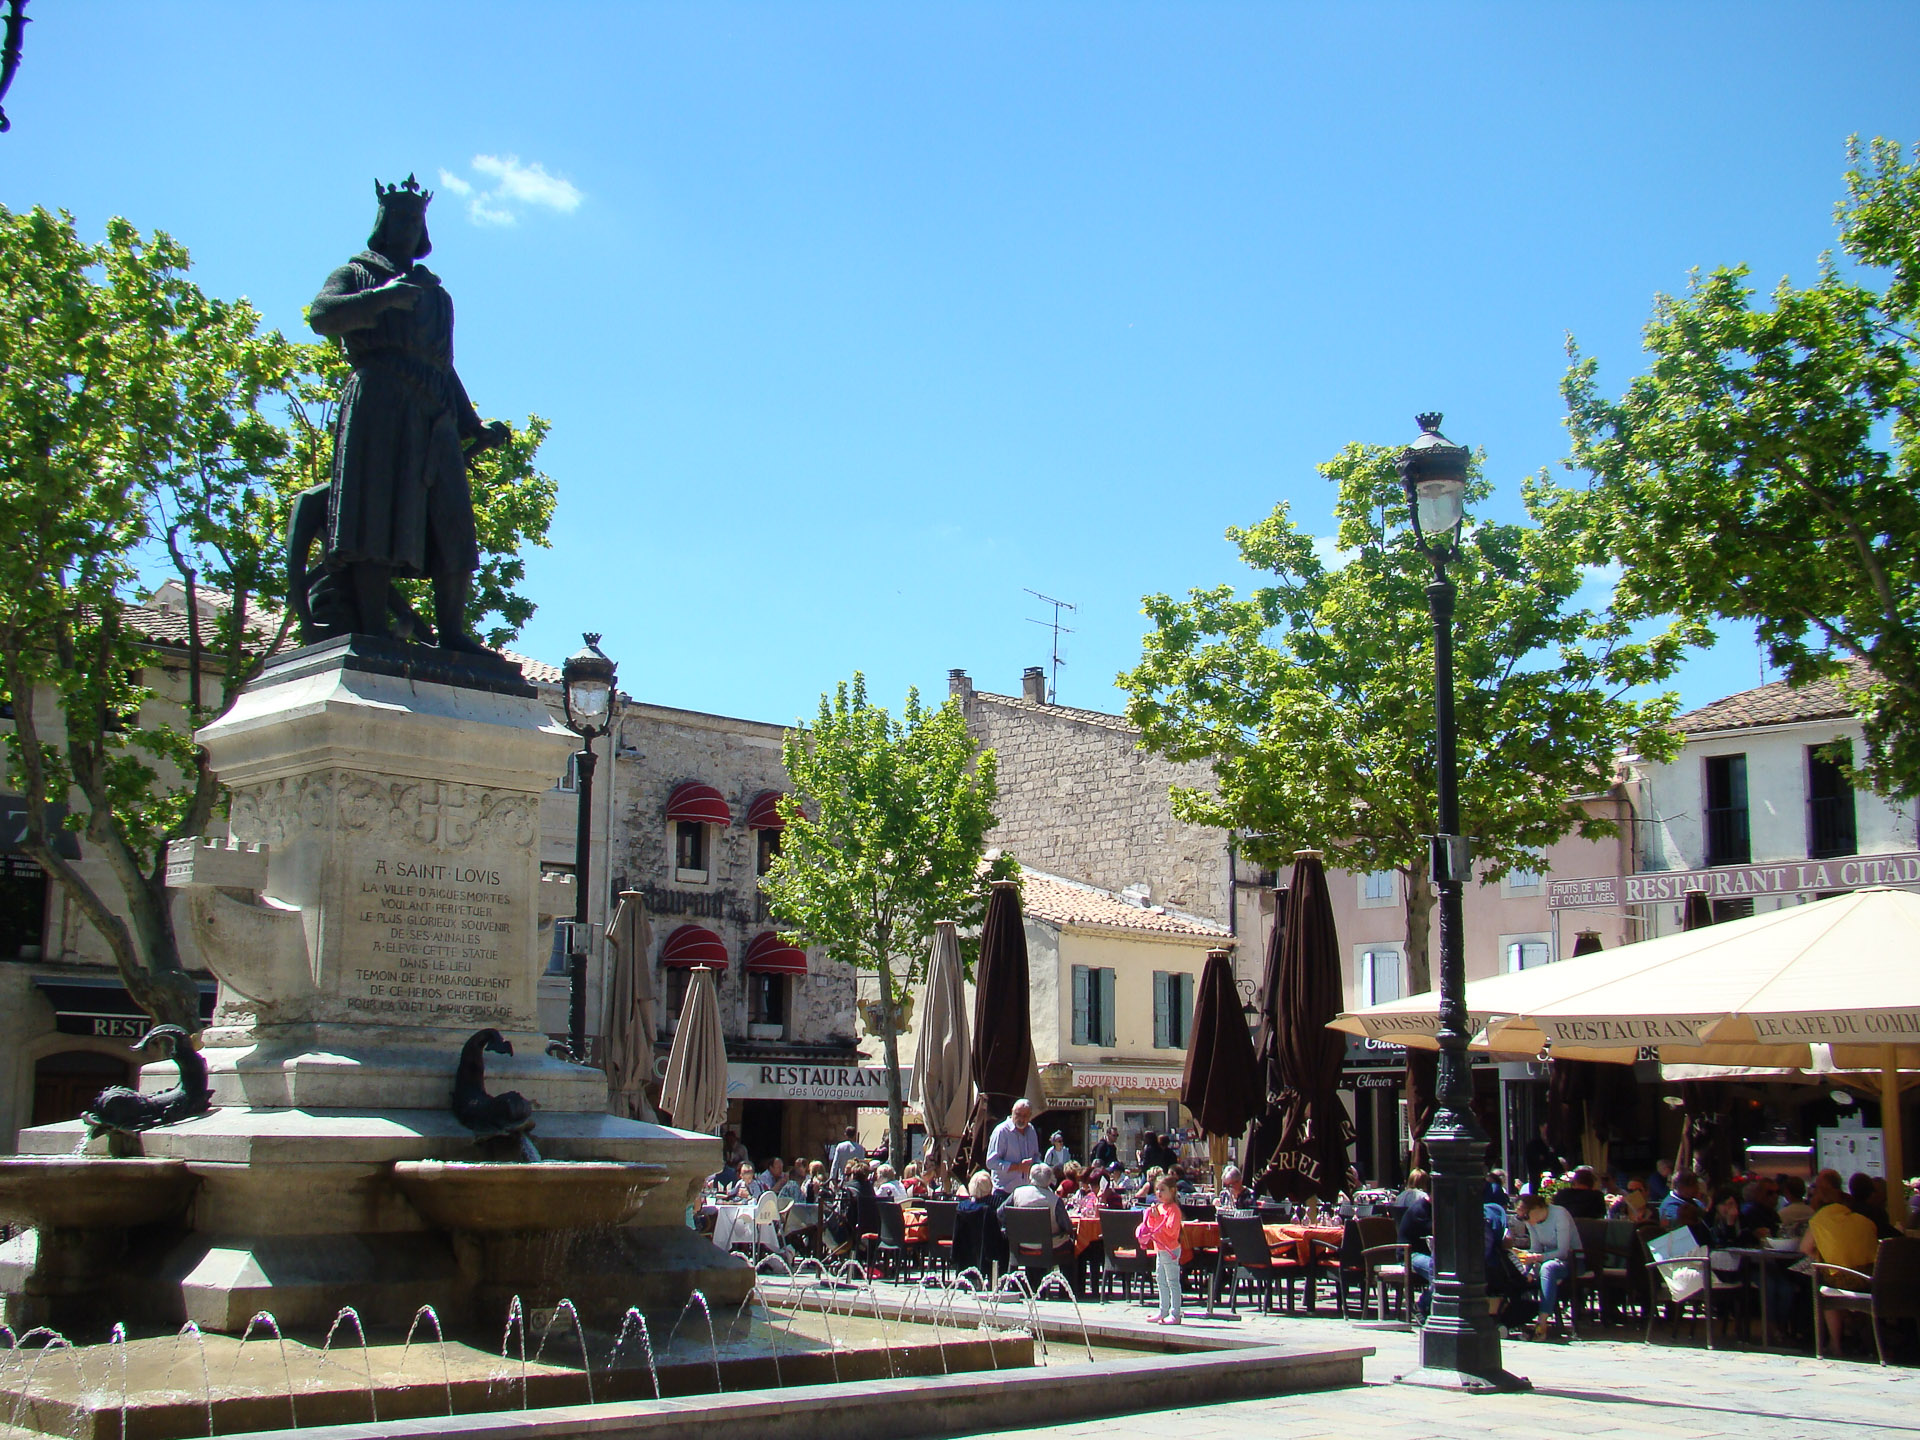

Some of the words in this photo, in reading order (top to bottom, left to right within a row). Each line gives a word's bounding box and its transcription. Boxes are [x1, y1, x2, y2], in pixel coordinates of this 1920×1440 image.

[396, 861, 446, 880] SAINT
[455, 867, 500, 886] LOVIS
[362, 881, 378, 893] LA
[384, 884, 415, 897] VILLE
[1552, 883, 1579, 896] FRUITS
[1581, 882, 1593, 894] DE
[1594, 880, 1612, 892] MER
[1626, 867, 1786, 900] RESTAURANT
[1797, 865, 1832, 889] LA
[381, 898, 432, 912] VOULANT
[1550, 895, 1560, 907] ET
[1563, 891, 1616, 906] COQUILLAGES
[360, 911, 373, 922] LE
[376, 912, 402, 924] PLUS
[407, 915, 457, 929] GLORIEUX
[461, 919, 512, 934] SOUVENIR
[391, 928, 405, 939] DE
[410, 930, 430, 941] SES
[432, 931, 481, 945] ANNALES
[422, 945, 457, 957] CETTE
[462, 948, 499, 961] STATUE
[400, 957, 429, 970] DANS
[433, 960, 446, 971] LE
[450, 961, 472, 973] LIEU
[355, 968, 398, 982] TEMOIN
[401, 972, 416, 983] DE
[370, 984, 385, 996] DE
[389, 986, 404, 998] CE
[407, 987, 442, 999] HEROS
[1369, 1015, 1443, 1032] POISSO
[1754, 1018, 1781, 1036] LE
[1782, 1015, 1831, 1036] CAFE
[1831, 1014, 1861, 1034] DU
[759, 1065, 888, 1087] RESTAURAN
[1078, 1074, 1138, 1087] SOUVENIRS
[1145, 1076, 1179, 1088] TABAC
[1356, 1074, 1393, 1088] Glacier
[788, 1085, 808, 1096] des
[811, 1085, 865, 1100] Voyageurs
